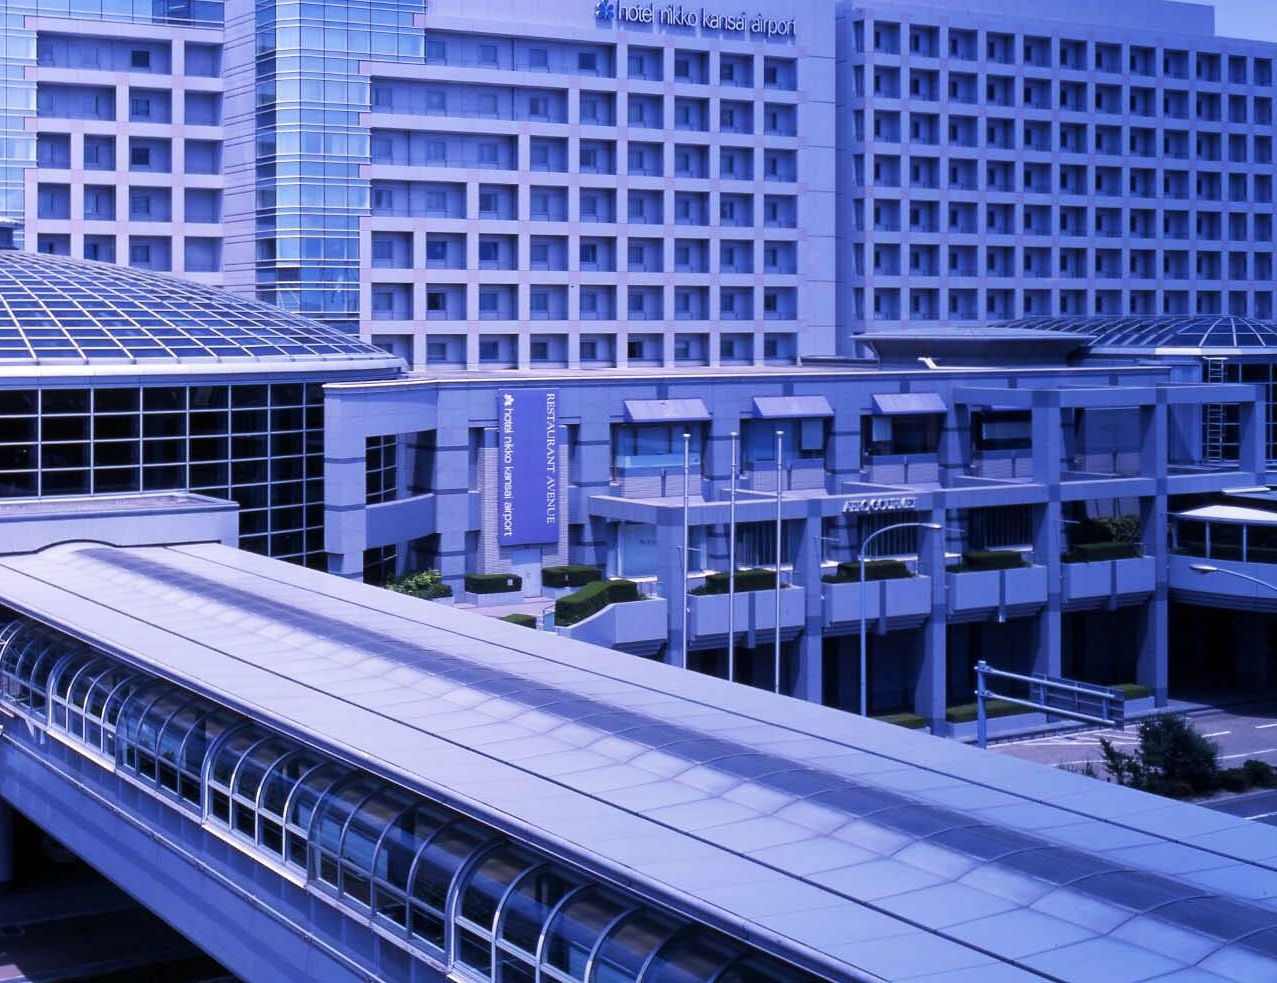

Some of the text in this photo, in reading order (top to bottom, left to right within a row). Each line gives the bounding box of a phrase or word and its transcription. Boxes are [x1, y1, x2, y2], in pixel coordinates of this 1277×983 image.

[617, 0, 796, 38] hotel nikko kansai airport
[503, 408, 515, 536] hotel nikko kansai airport
[546, 393, 555, 525] RESTAURANT AVENUE
